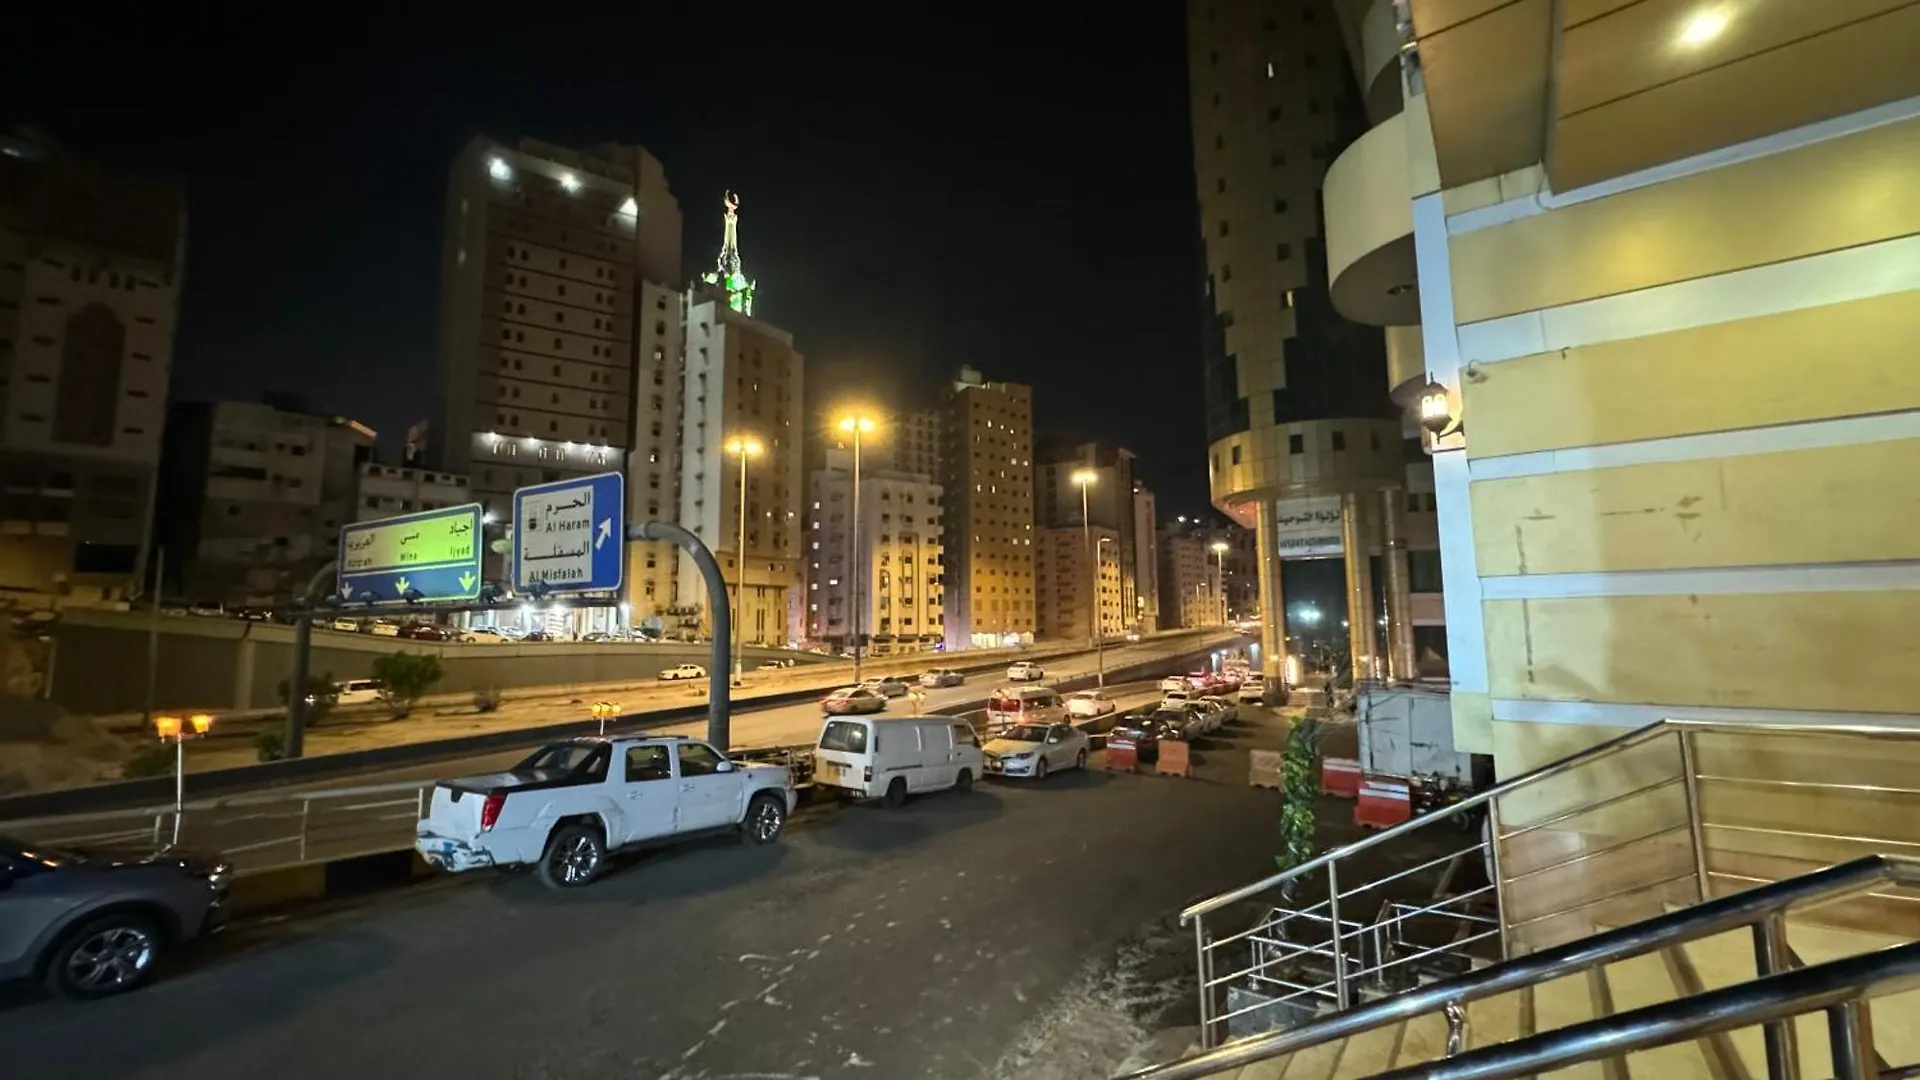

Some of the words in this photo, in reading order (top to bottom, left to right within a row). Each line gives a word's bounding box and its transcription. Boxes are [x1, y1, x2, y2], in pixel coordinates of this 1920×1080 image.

[546, 491, 591, 521] الحرم
[545, 521, 556, 533] Al
[559, 518, 590, 532] Haram
[524, 540, 590, 561] المسفلة
[528, 570, 539, 583] Al
[542, 567, 584, 582] Misfalah
